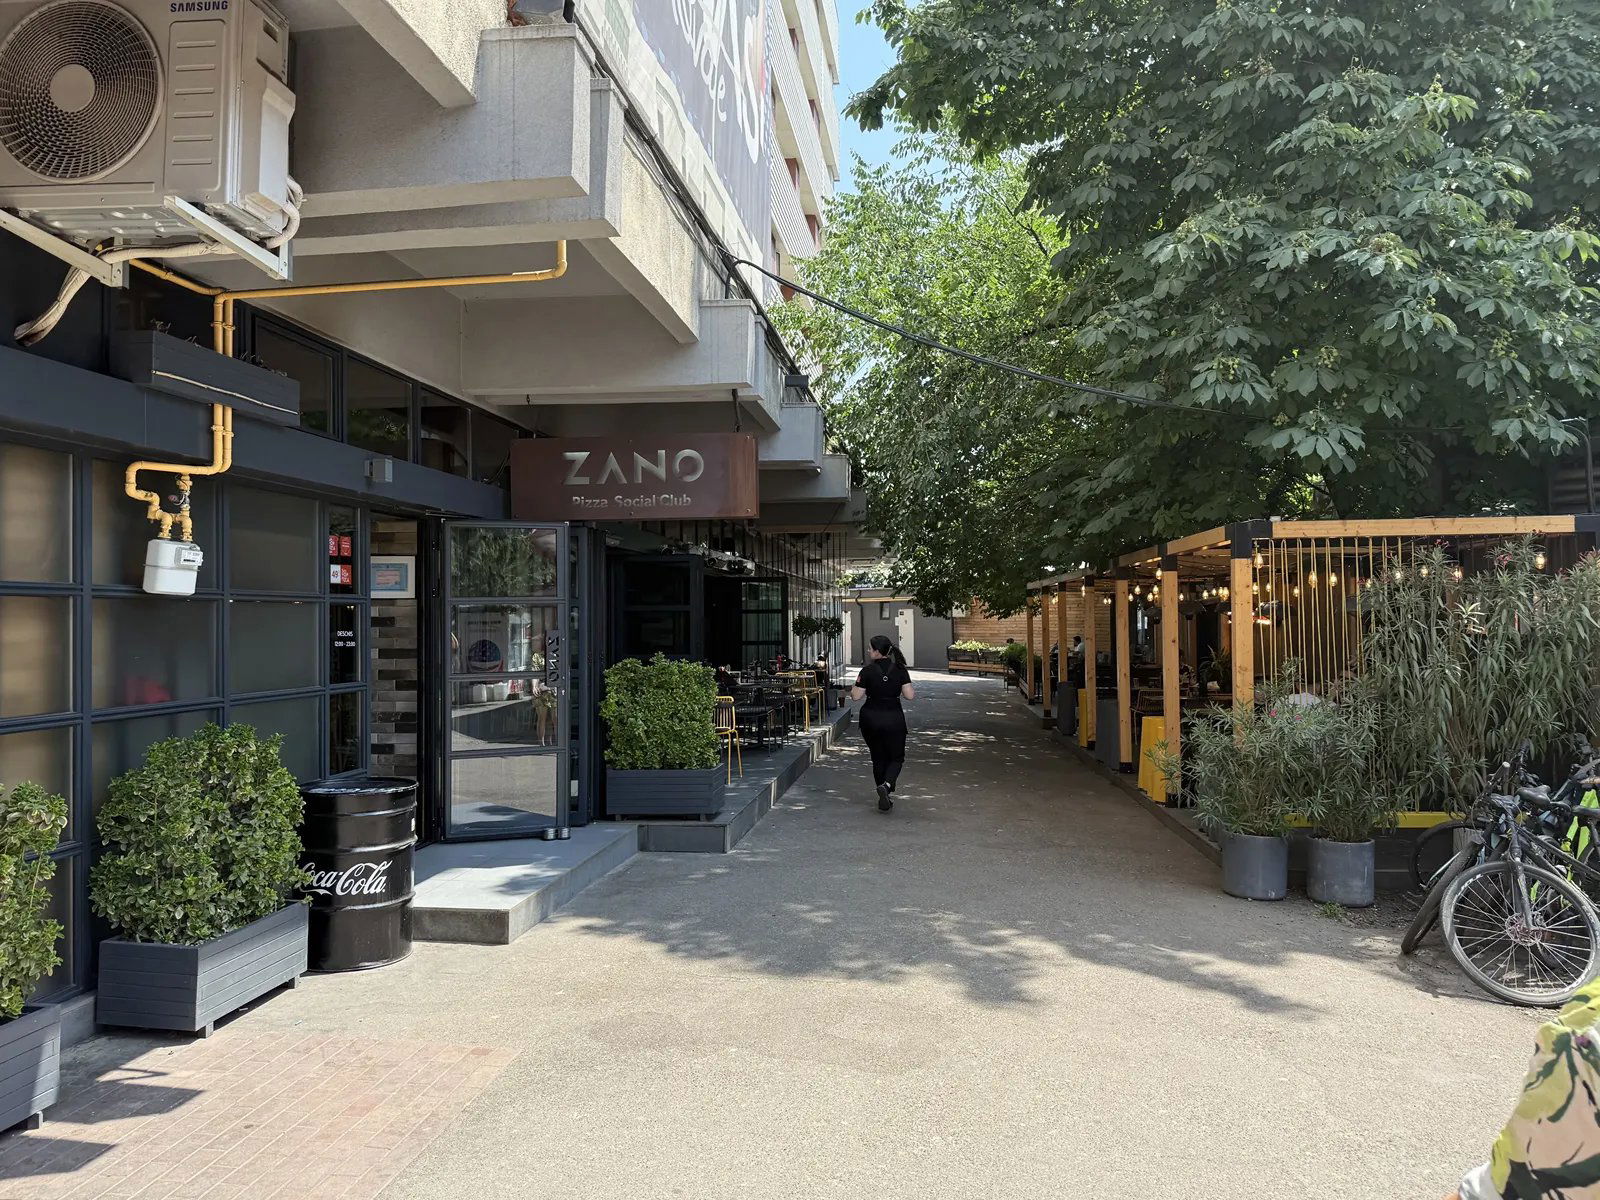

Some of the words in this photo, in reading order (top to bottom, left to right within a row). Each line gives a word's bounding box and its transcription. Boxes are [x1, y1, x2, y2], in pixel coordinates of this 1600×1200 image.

[170, 0, 228, 12] SAMSUNG
[562, 448, 705, 485] ZANO
[572, 496, 608, 508] Pizza
[614, 495, 656, 508] Social
[659, 493, 692, 507] Club
